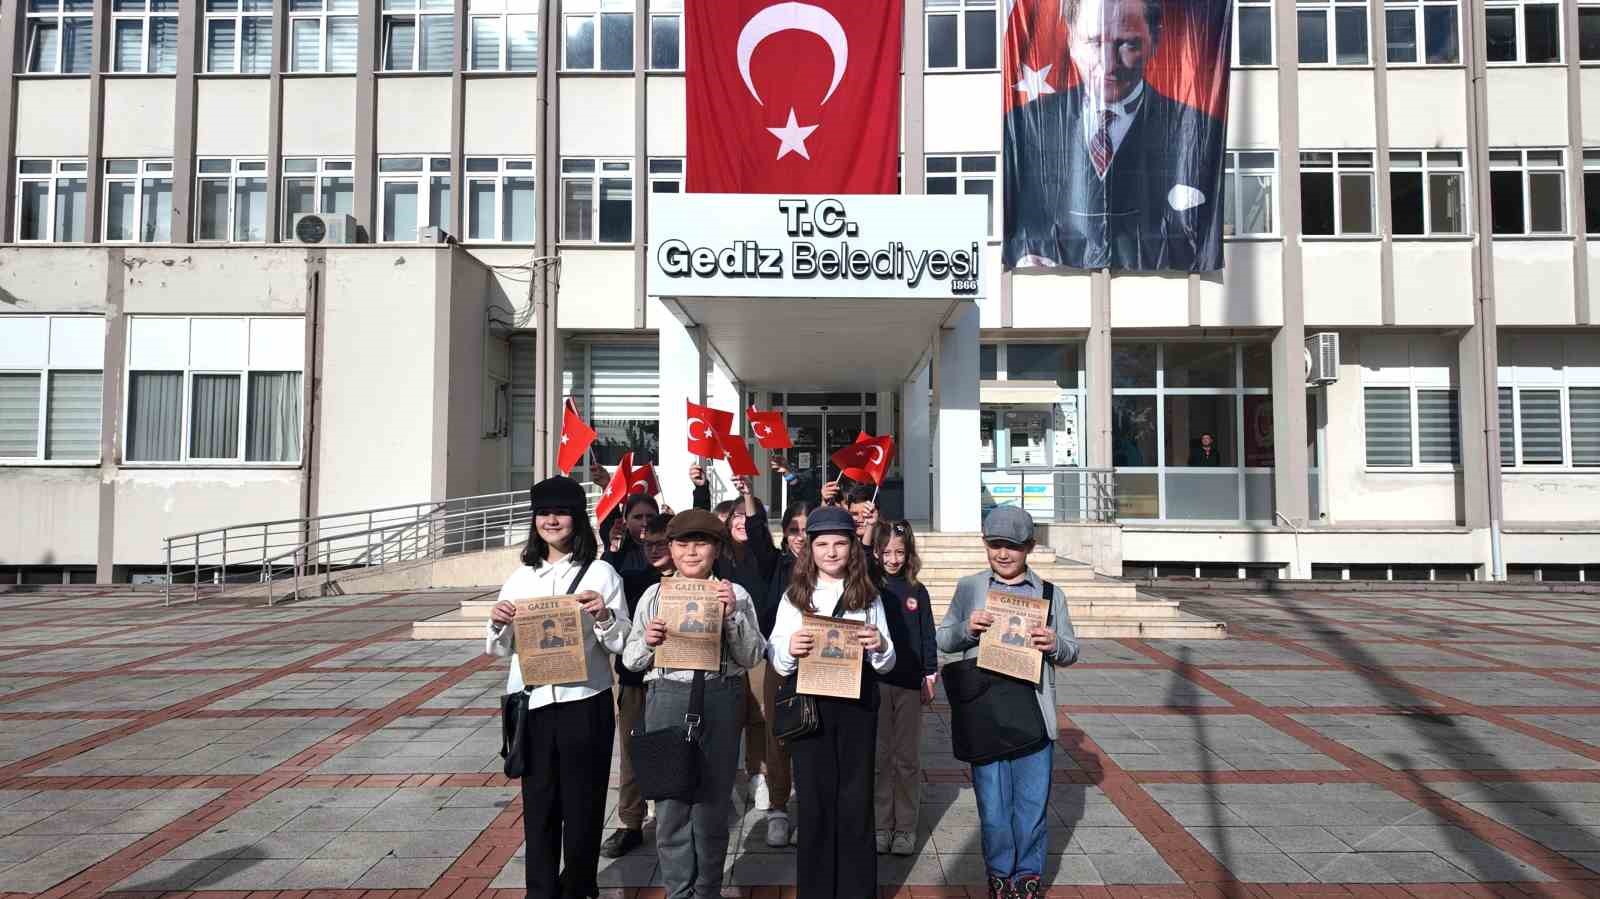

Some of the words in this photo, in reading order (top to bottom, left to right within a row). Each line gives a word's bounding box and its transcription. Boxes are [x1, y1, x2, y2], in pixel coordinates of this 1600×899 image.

[778, 199, 859, 237] T.C.
[657, 239, 783, 279] Gediz
[791, 241, 979, 288] Belediyesi
[527, 601, 560, 611] GAZETE
